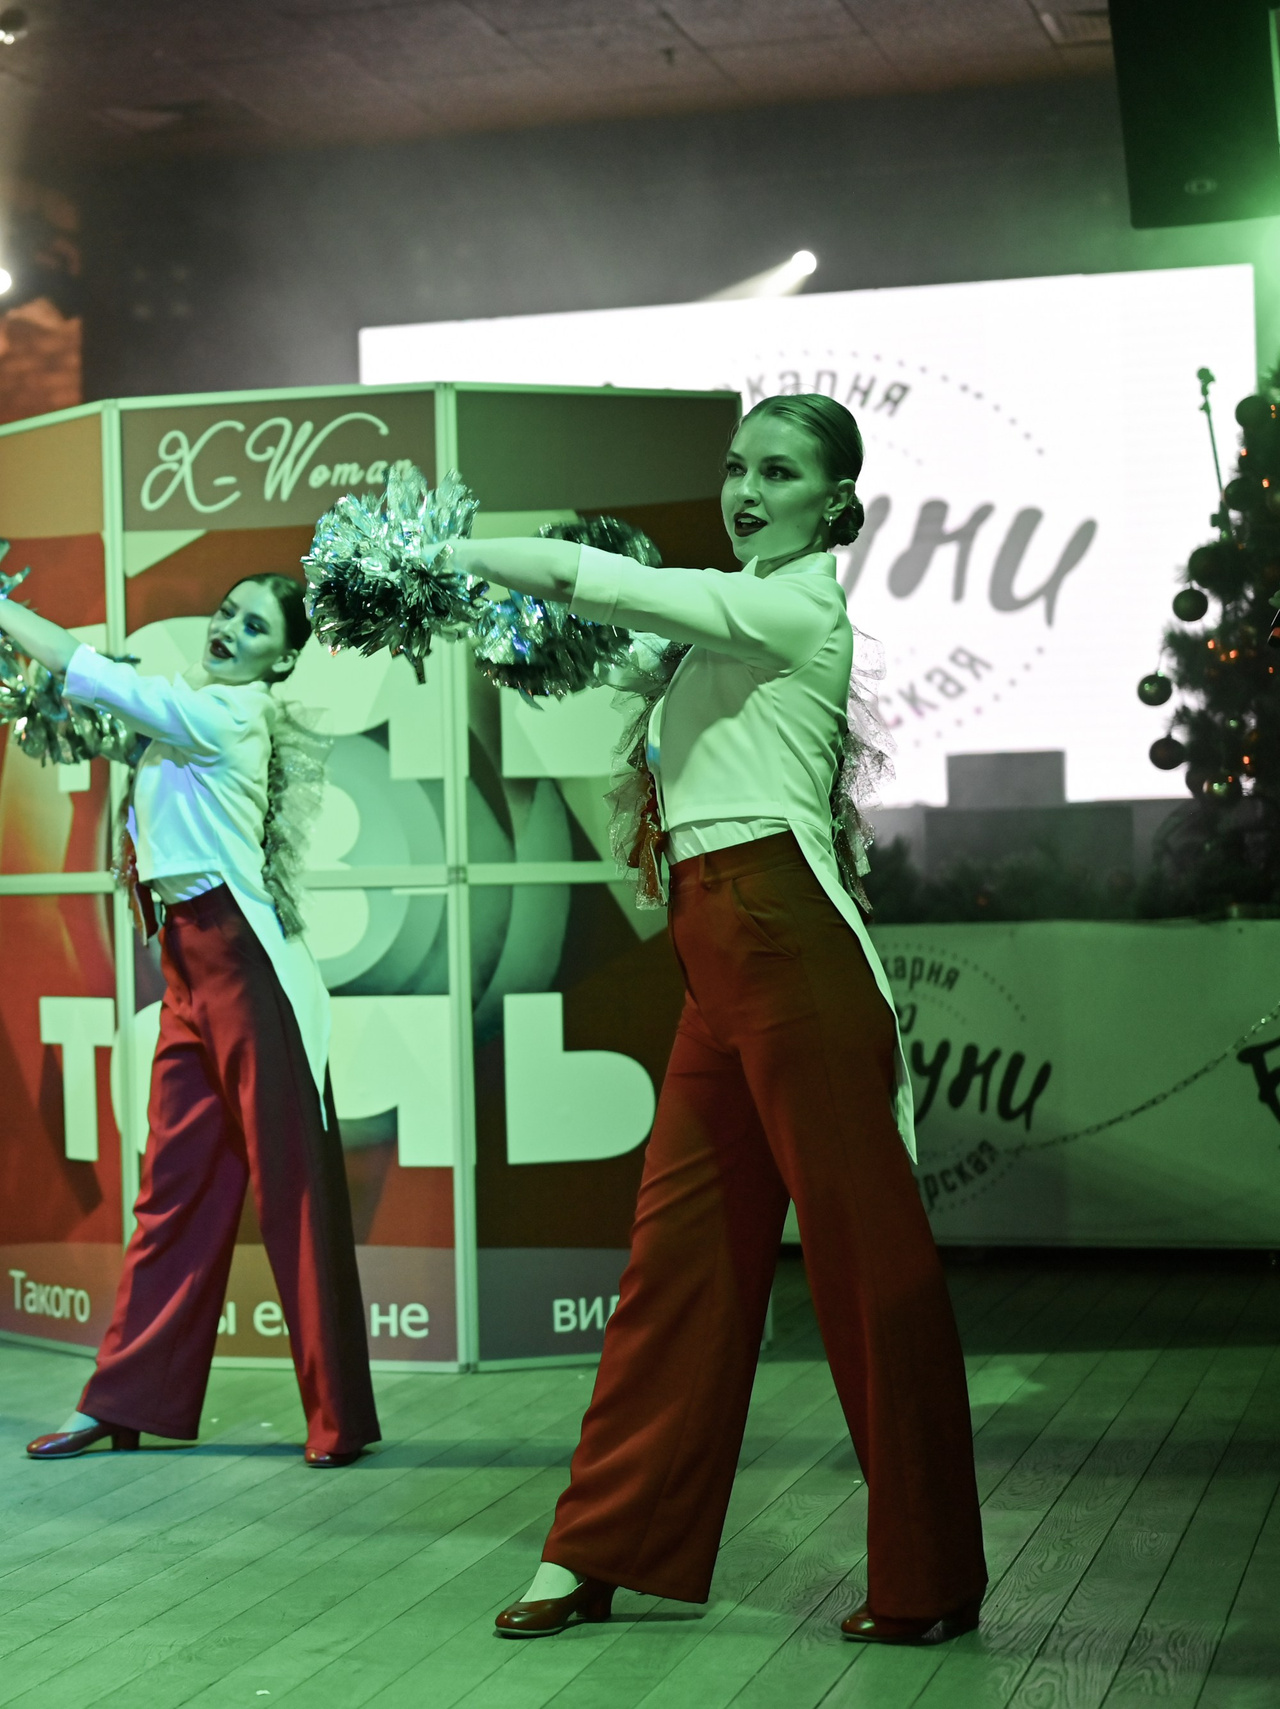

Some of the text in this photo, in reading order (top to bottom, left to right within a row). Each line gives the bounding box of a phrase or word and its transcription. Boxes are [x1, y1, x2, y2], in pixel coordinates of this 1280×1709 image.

[836, 494, 1098, 628] уни
[911, 1038, 1052, 1132] уни
[9, 1270, 90, 1322] Такого
[370, 1301, 429, 1338] не
